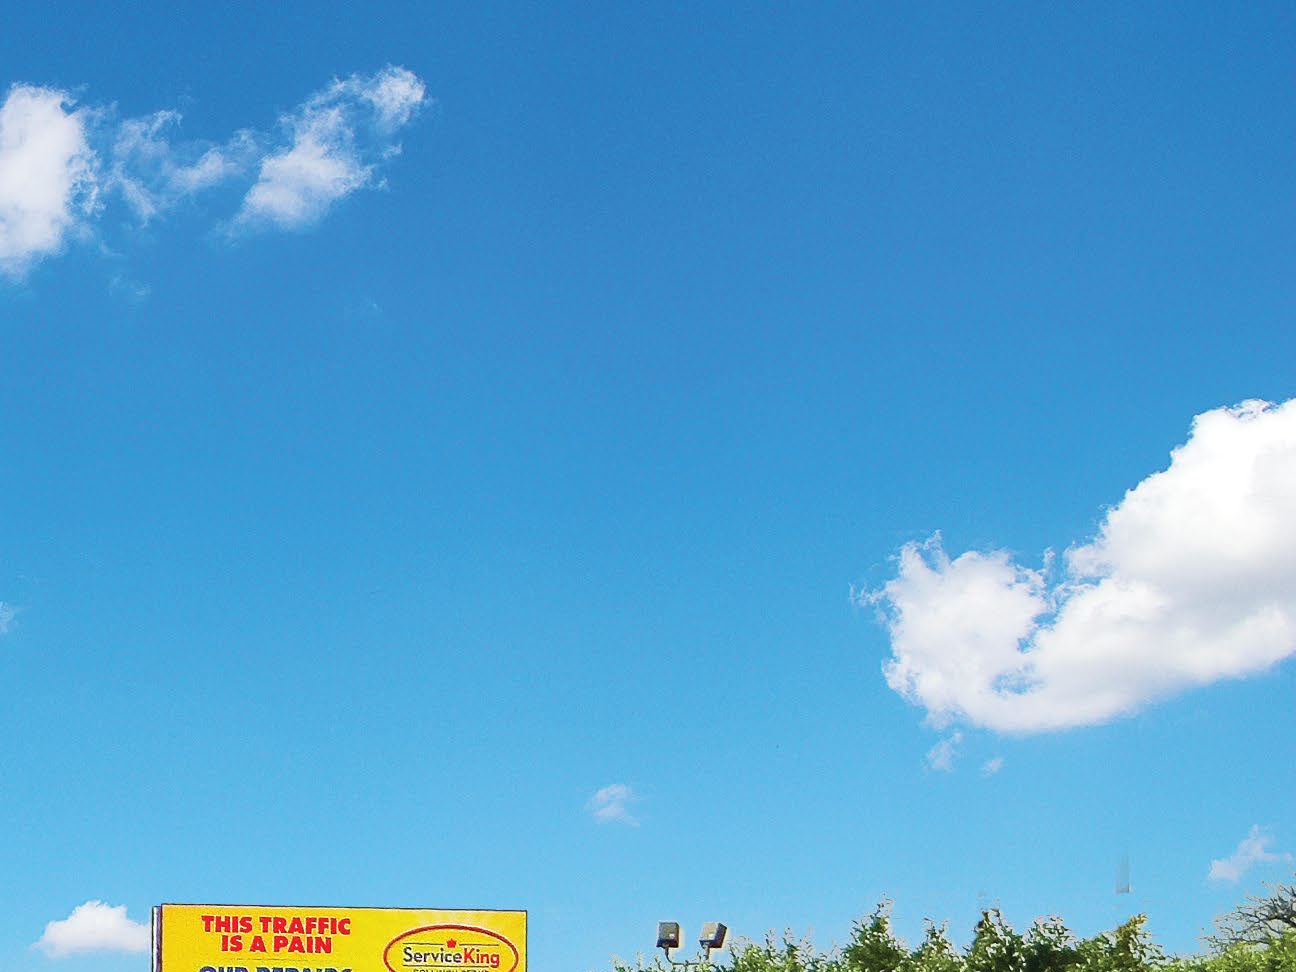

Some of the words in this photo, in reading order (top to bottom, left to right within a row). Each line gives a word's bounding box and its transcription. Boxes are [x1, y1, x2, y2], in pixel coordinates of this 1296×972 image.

[201, 915, 253, 933] THIS
[259, 916, 351, 935] TRAFFIC
[221, 935, 244, 952] IS
[250, 936, 266, 952] A
[273, 936, 332, 954] PAIN
[403, 947, 500, 968] ServiceKing
